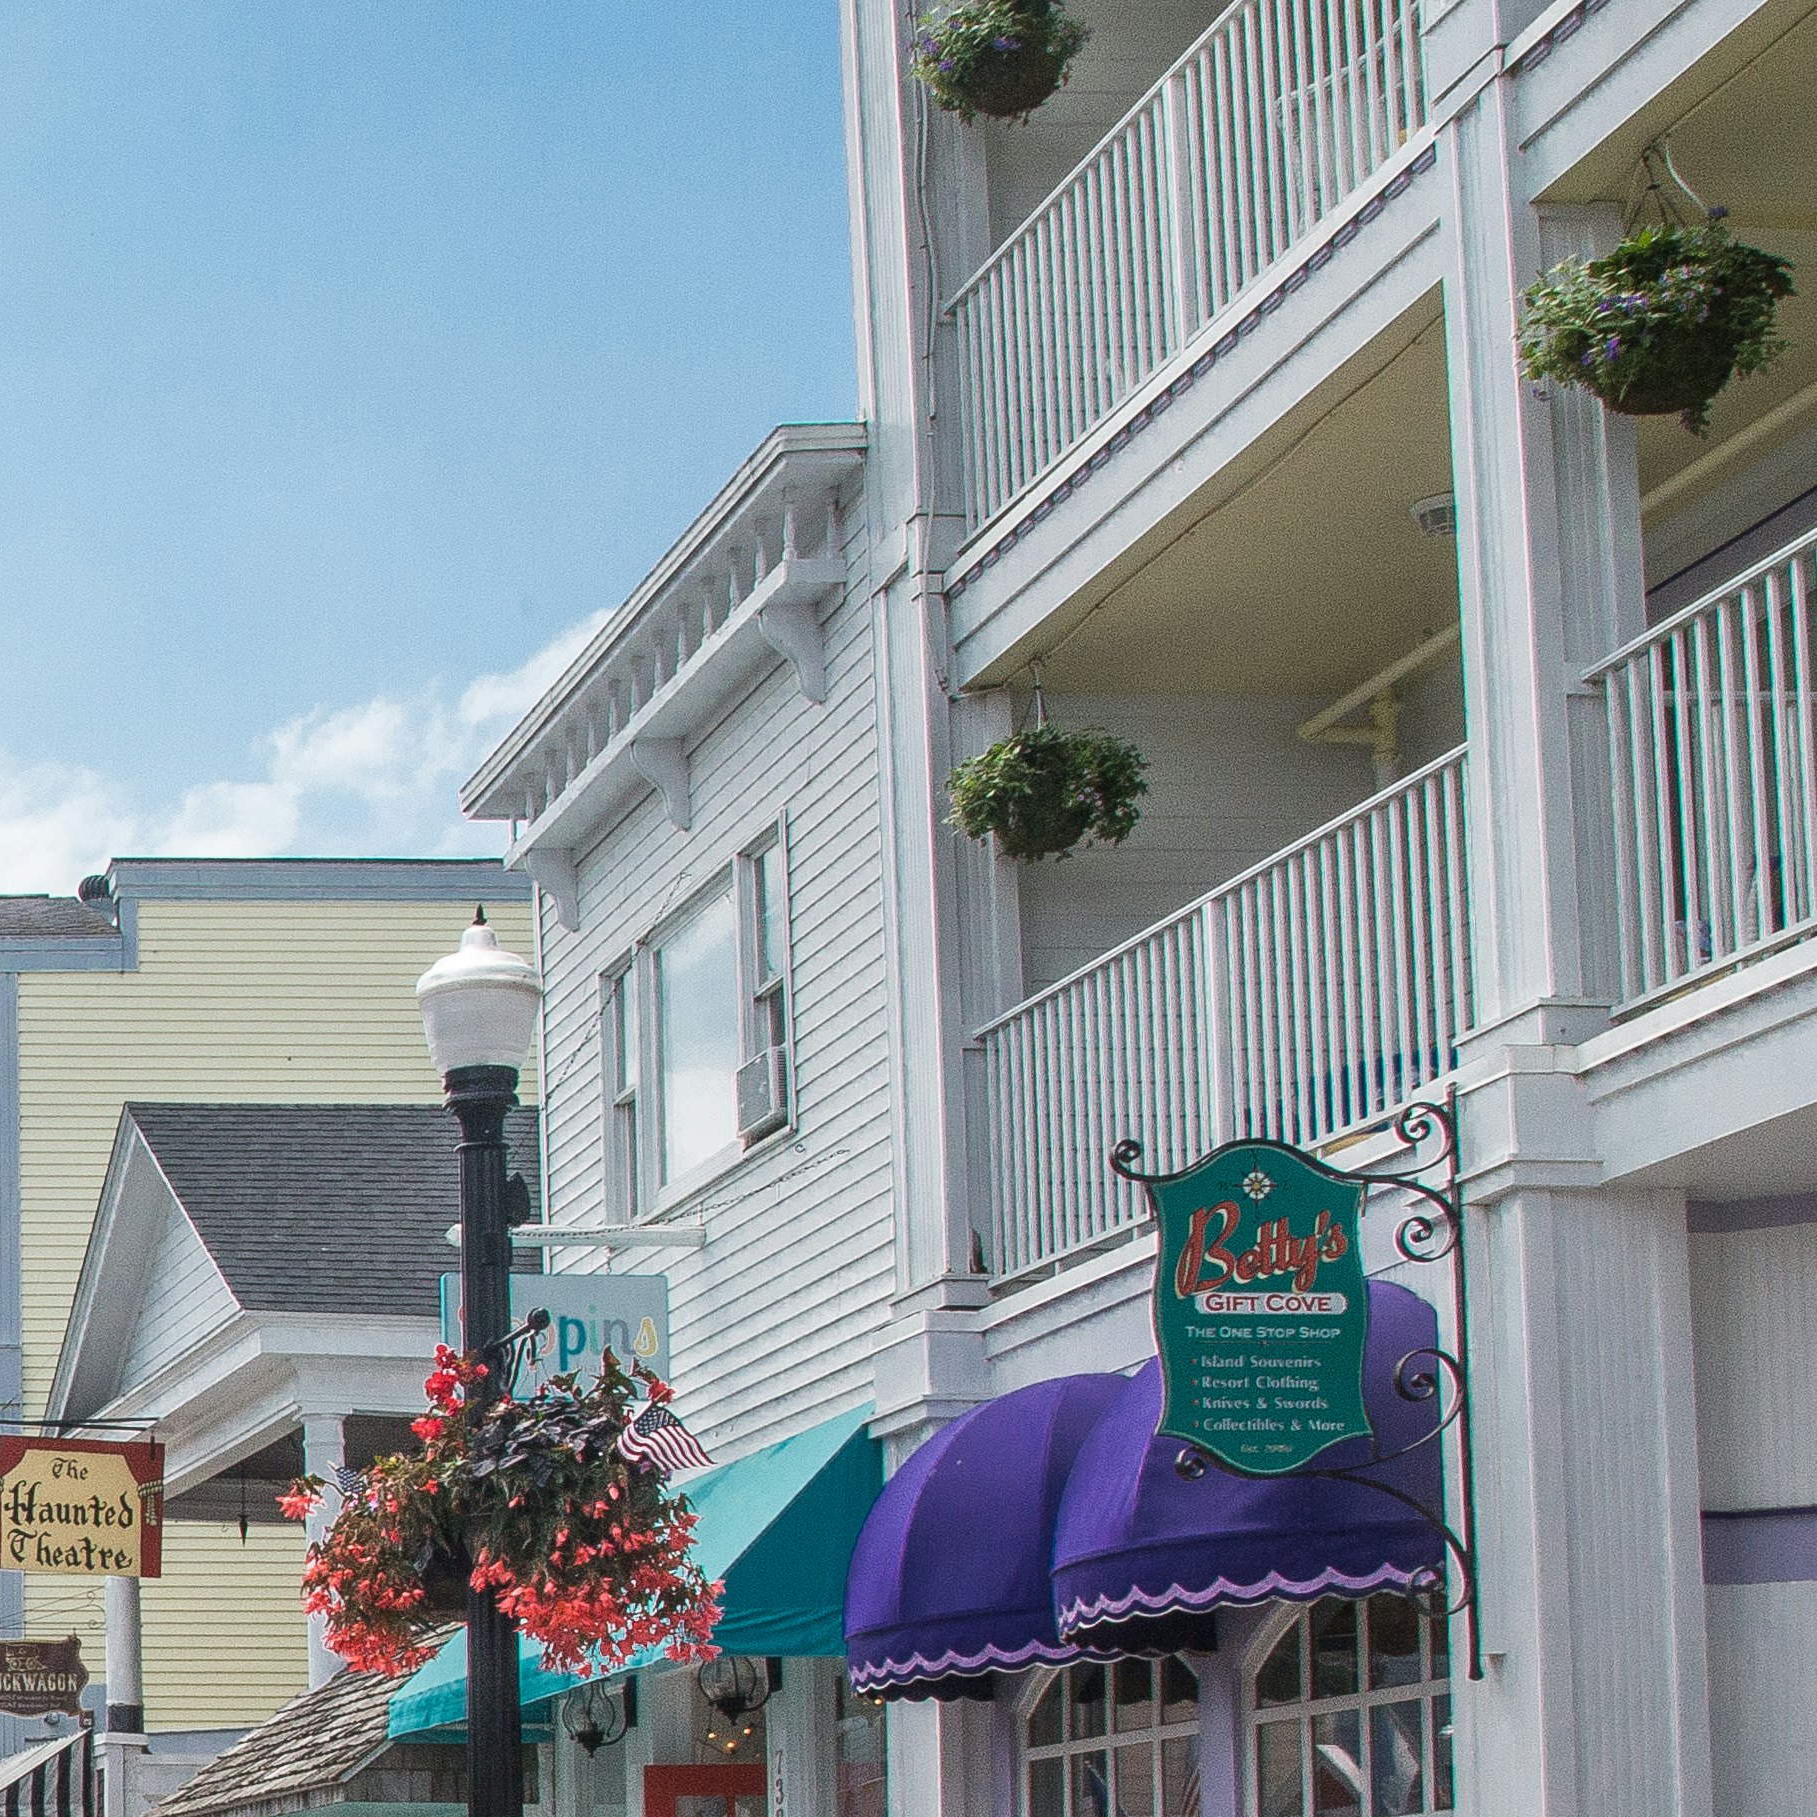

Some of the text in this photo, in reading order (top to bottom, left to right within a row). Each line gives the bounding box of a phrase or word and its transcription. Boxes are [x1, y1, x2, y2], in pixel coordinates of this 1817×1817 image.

[1174, 1200, 1348, 1299] Betty's
[1205, 1294, 1332, 1311] GIFT COVE
[1185, 1326, 1341, 1339] THE ONE STOP SHOP
[1201, 1355, 1322, 1368] Island Souvenirs
[1201, 1375, 1320, 1392] Resort Clothing
[1202, 1396, 1329, 1409] Knives & Swords
[1203, 1417, 1345, 1431] Collectibles & More
[50, 1457, 88, 1480] The
[4, 1480, 133, 1529] Haunted
[7, 1528, 133, 1570] Theatre
